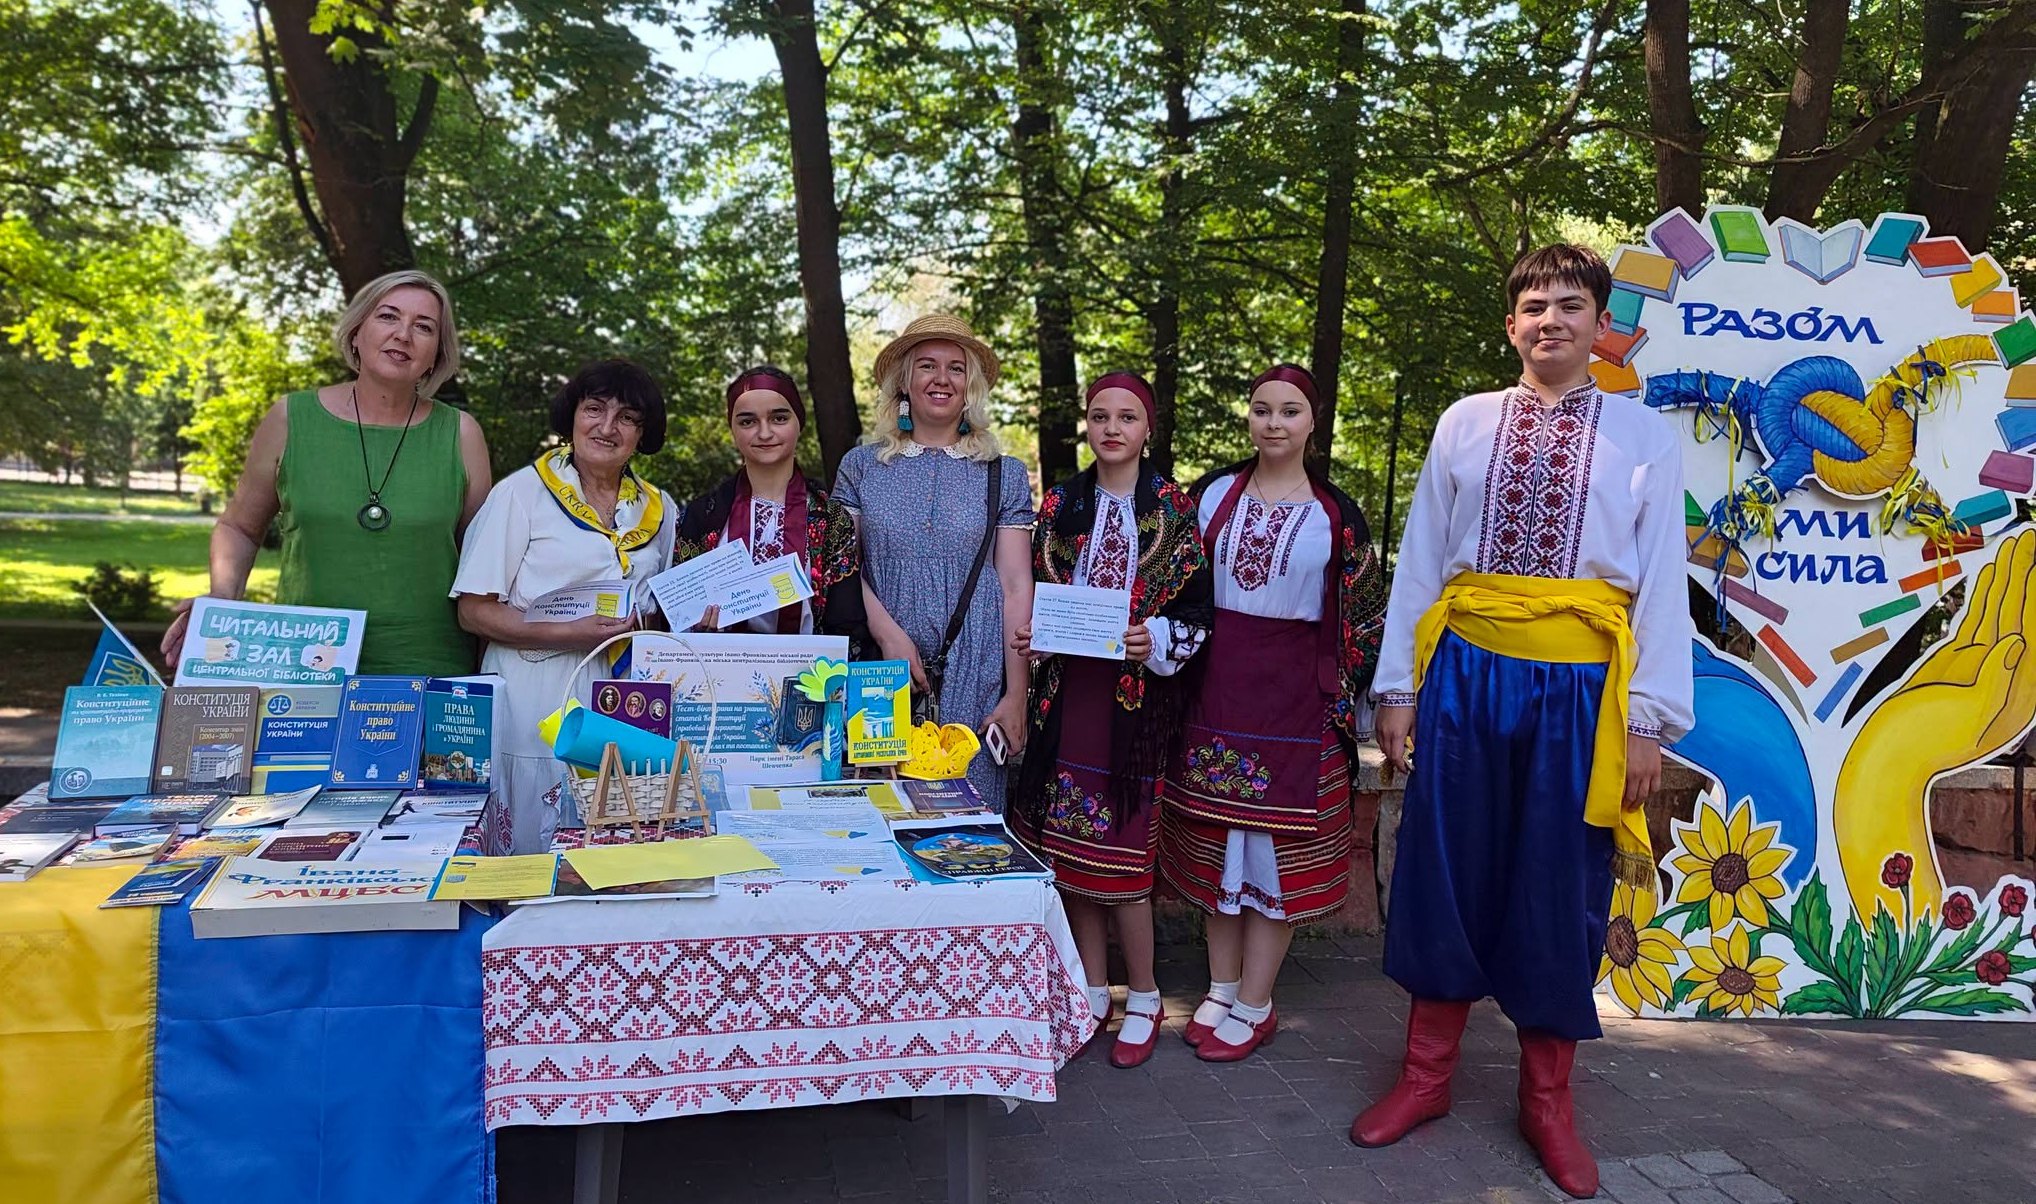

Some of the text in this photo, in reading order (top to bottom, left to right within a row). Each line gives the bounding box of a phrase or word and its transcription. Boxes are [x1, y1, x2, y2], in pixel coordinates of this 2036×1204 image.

[731, 588, 751, 599] День
[534, 601, 590, 610] Конституції
[719, 590, 769, 612] Конституції
[544, 608, 577, 616] України
[730, 602, 762, 616] України
[210, 614, 340, 642] ЧИТАЛЬНИЙ
[246, 644, 292, 666] ЗАЛ
[192, 664, 336, 681] ЦЕНТРАЛЬНОЇ БІБЛІОТЕКИ
[851, 666, 905, 676] КОНСТИТУЦІЯ
[861, 676, 894, 686] УКРАЇНИ
[76, 698, 150, 709] Конституційне
[173, 693, 250, 708] КОНСТИТУЦІЯ
[202, 706, 249, 718] УКРАЇНИ
[349, 700, 416, 714] Конституційне
[444, 702, 475, 716] ПРАВА
[73, 714, 145, 726] право України
[366, 717, 393, 727] право
[443, 715, 475, 725] ЛЮДИНИ
[703, 714, 746, 723] Коституції
[268, 721, 329, 730] КОНСТИТУЦІЯ
[435, 724, 486, 736] ГРОМАДЯНИНА
[266, 729, 303, 738] УКРАЇНИ
[360, 729, 396, 741] України
[447, 734, 474, 744] УКРАЇНІ
[853, 739, 907, 751] КОНСТИТУЦІЯ
[785, 754, 805, 762] Тараса
[299, 864, 415, 878] Івано-
[228, 872, 435, 887] Франківськ
